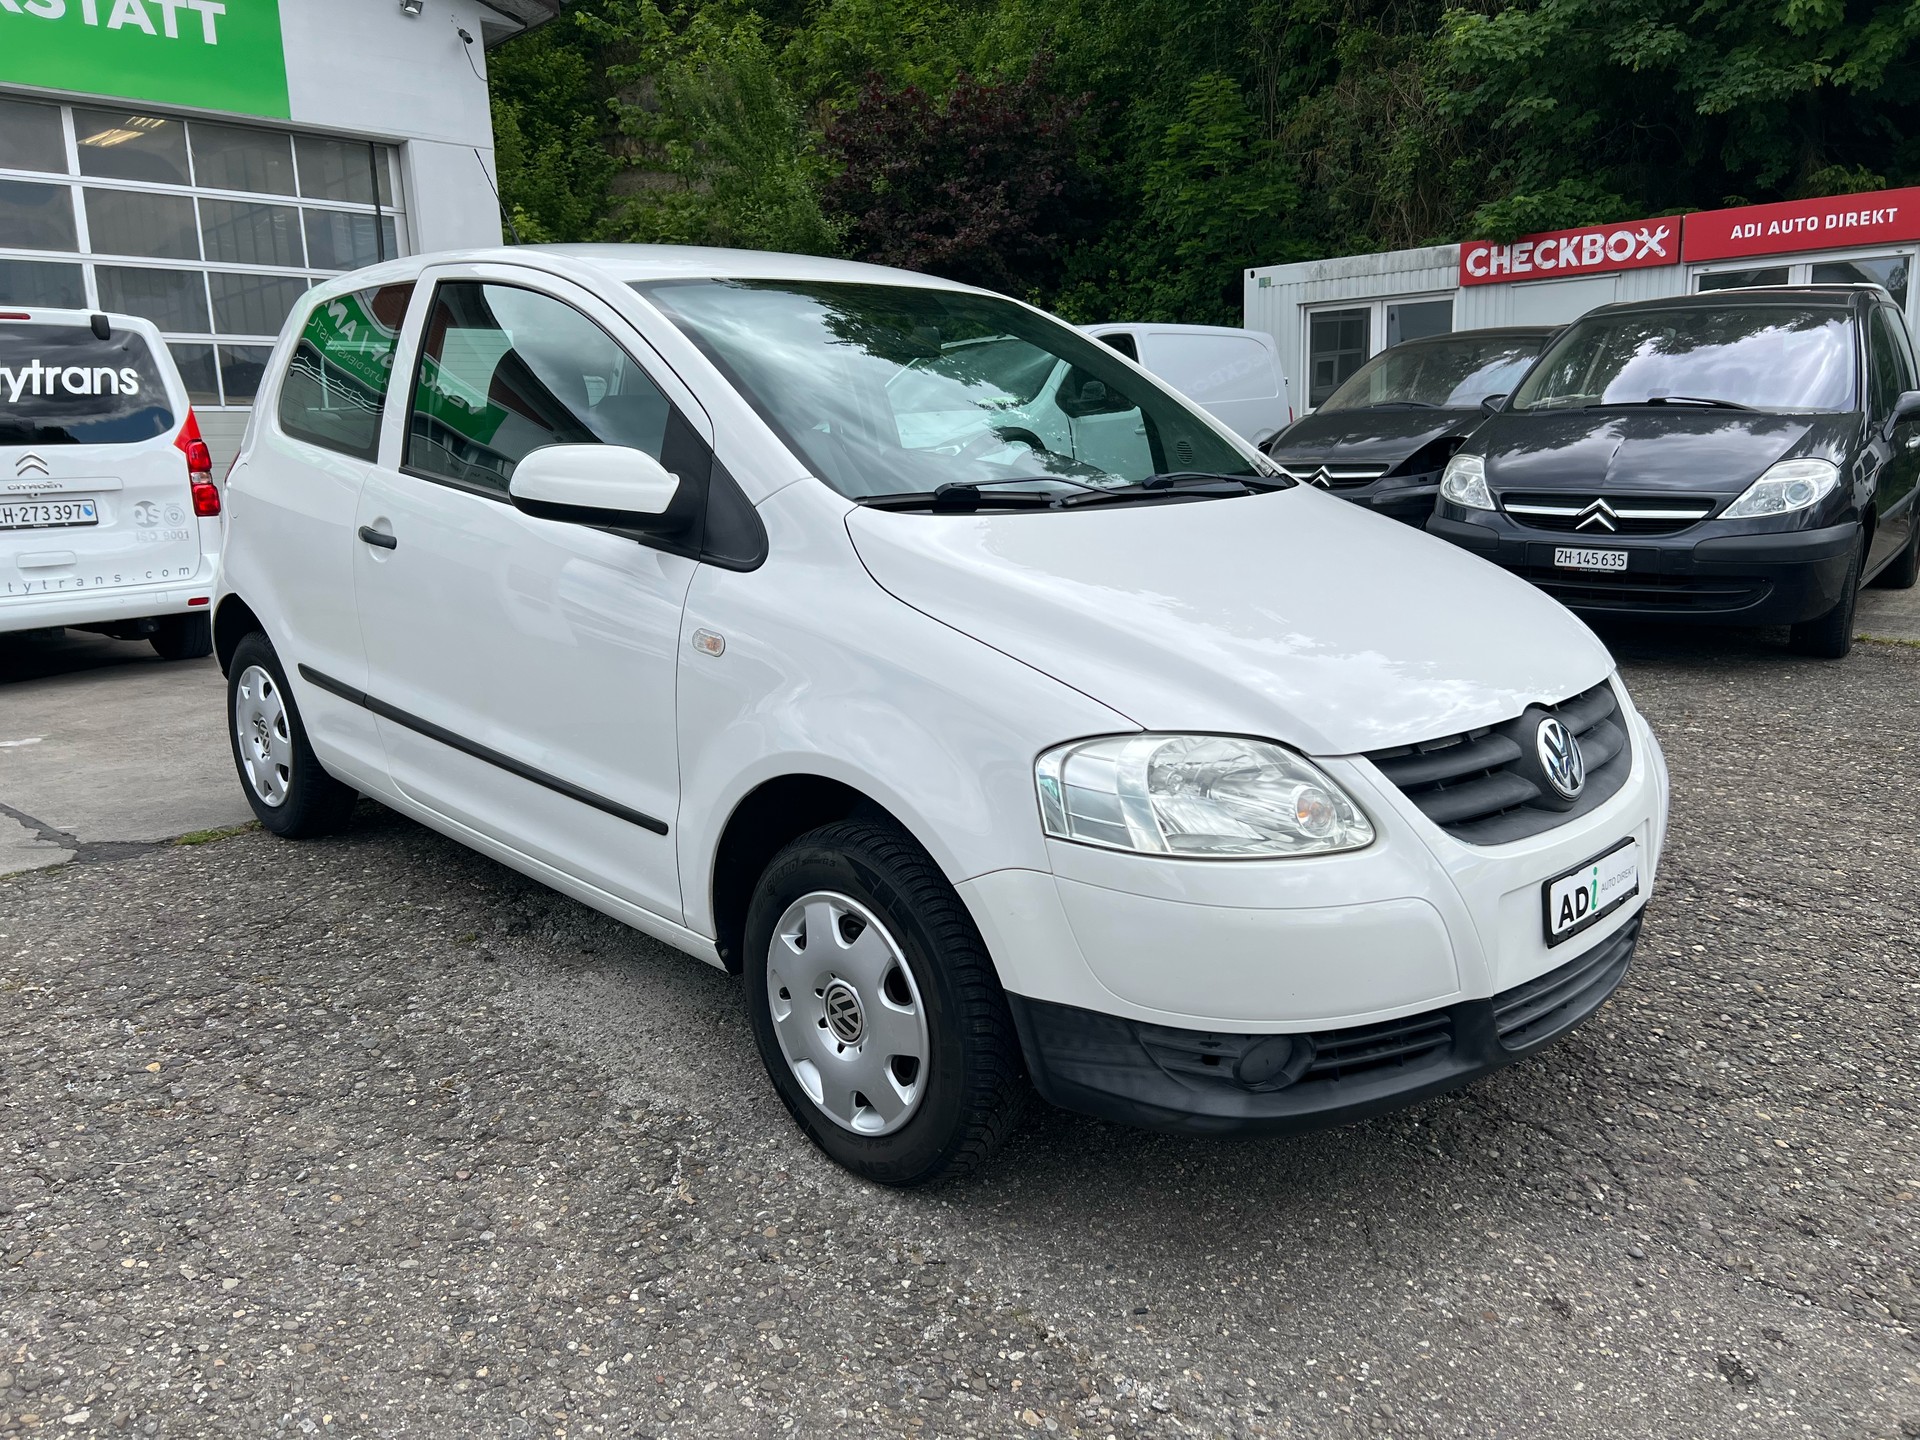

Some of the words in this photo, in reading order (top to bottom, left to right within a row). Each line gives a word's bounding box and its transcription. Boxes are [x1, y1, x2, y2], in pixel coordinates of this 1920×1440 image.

[0, 0, 226, 45] STATT
[1730, 222, 1762, 240] ADI
[1767, 216, 1819, 236] AUTO
[1825, 207, 1898, 230] DIREKT
[1466, 225, 1670, 277] CHECKBOX
[0, 359, 139, 403] ytrans
[163, 530, 189, 541] 9001
